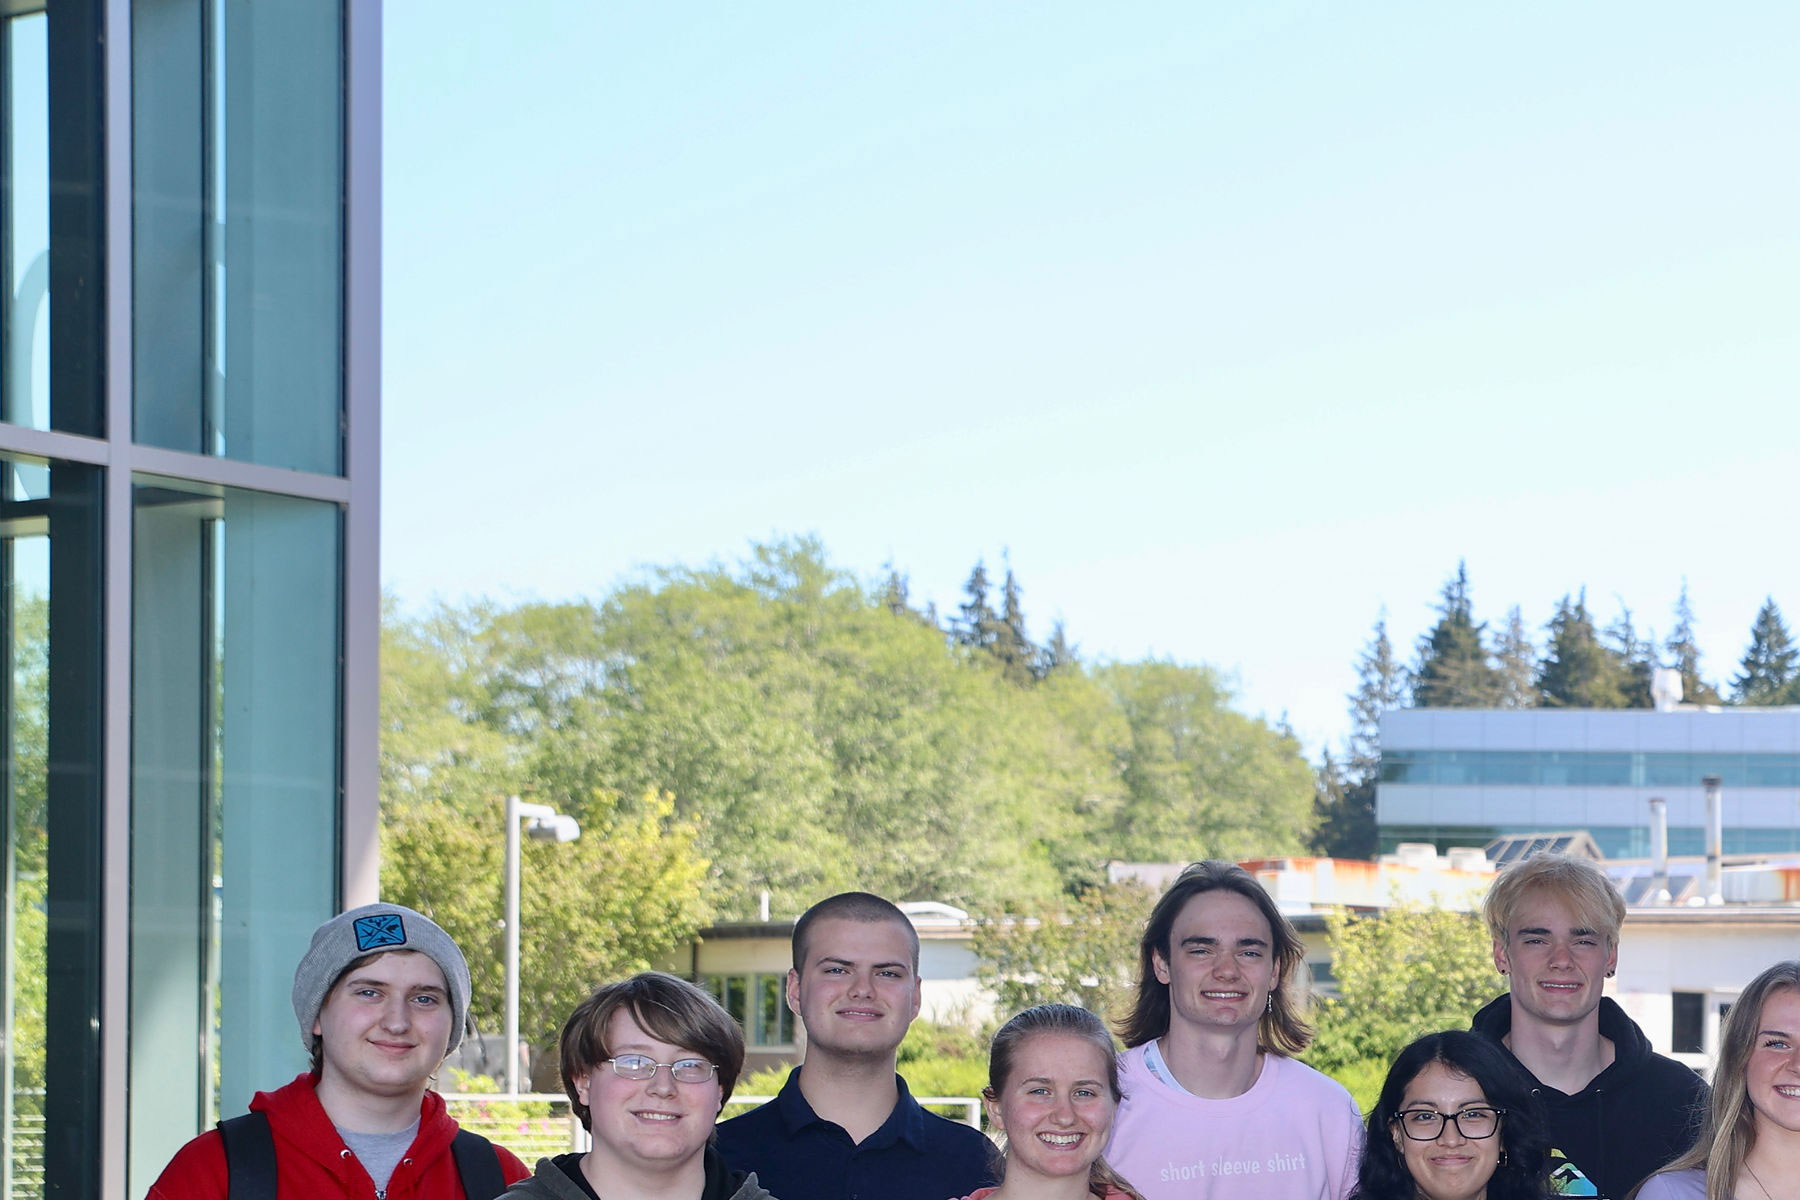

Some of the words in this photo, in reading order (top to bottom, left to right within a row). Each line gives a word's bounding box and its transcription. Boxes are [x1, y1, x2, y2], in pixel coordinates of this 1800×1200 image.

[1160, 1160, 1205, 1182] short
[1211, 1156, 1261, 1177] sleeve
[1267, 1153, 1307, 1173] shirt
